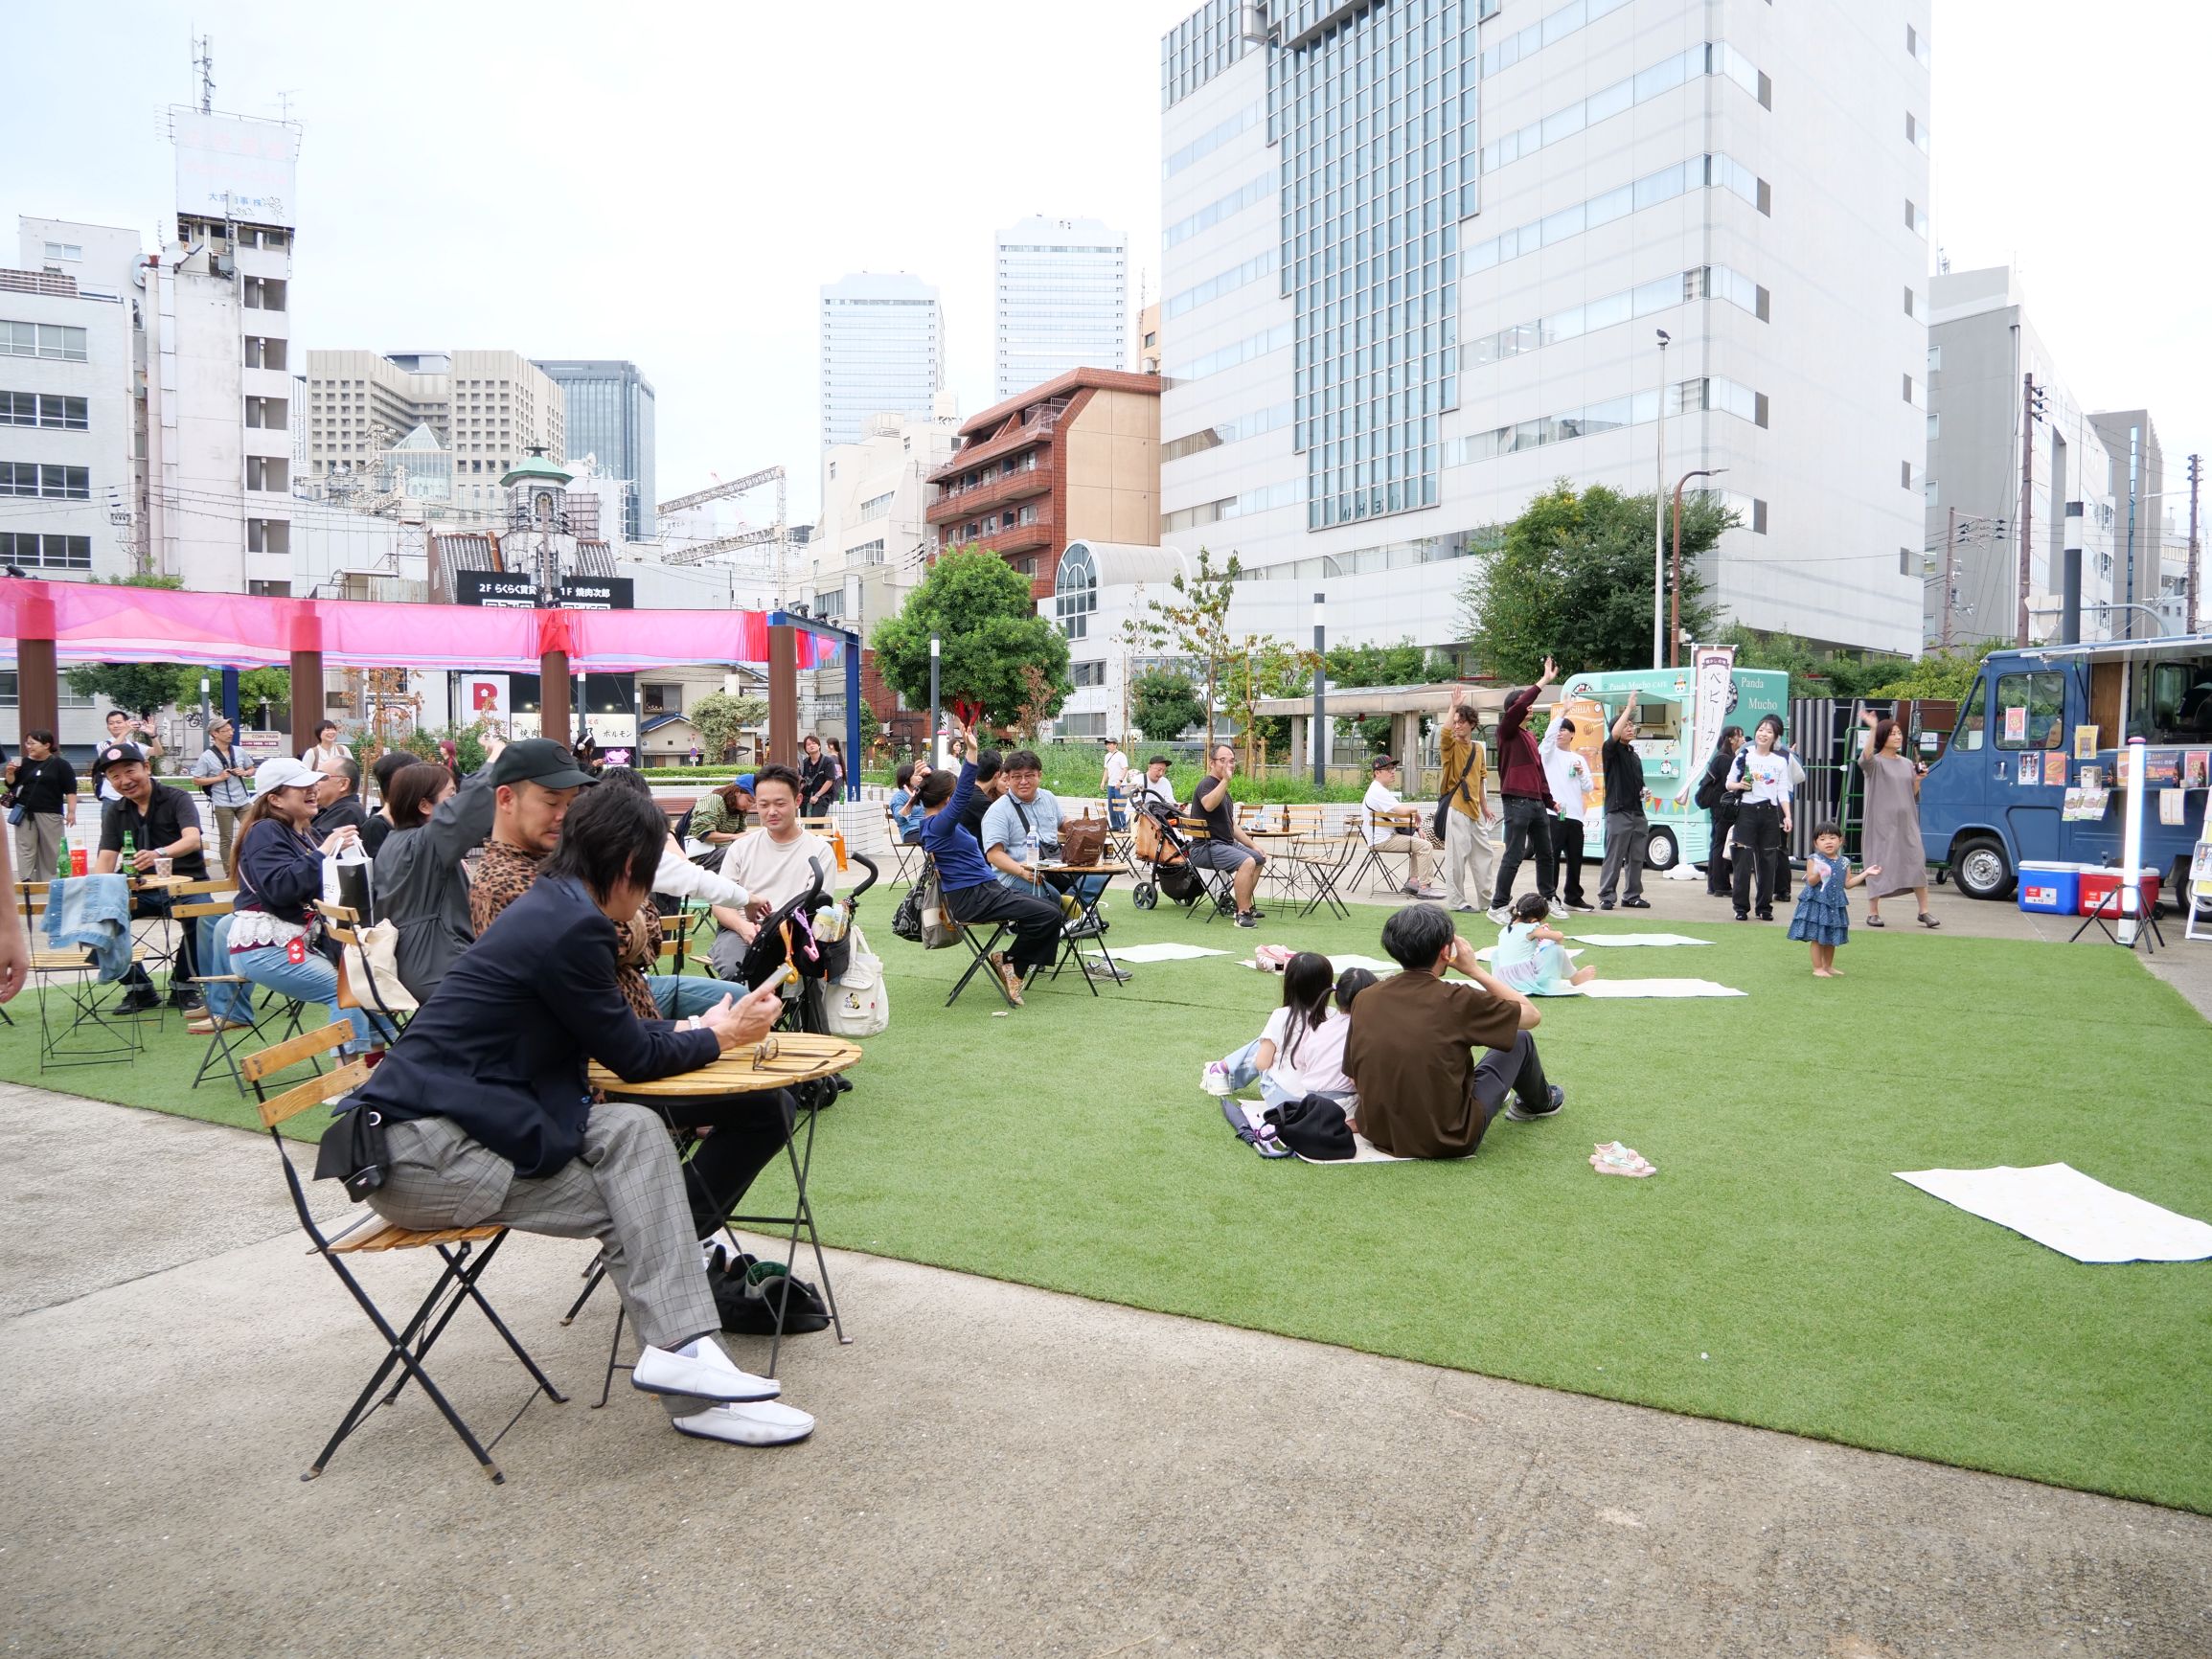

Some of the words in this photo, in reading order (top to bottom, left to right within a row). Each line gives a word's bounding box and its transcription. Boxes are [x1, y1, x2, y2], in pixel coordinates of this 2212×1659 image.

[479, 583, 492, 593] 2F
[560, 586, 573, 597] 1F
[575, 587, 611, 599] 焼肉次郎
[1628, 680, 1651, 690] Mucho
[1741, 676, 1765, 689] Panda
[1748, 696, 1778, 711] Mucho
[603, 729, 632, 739] ホルモン
